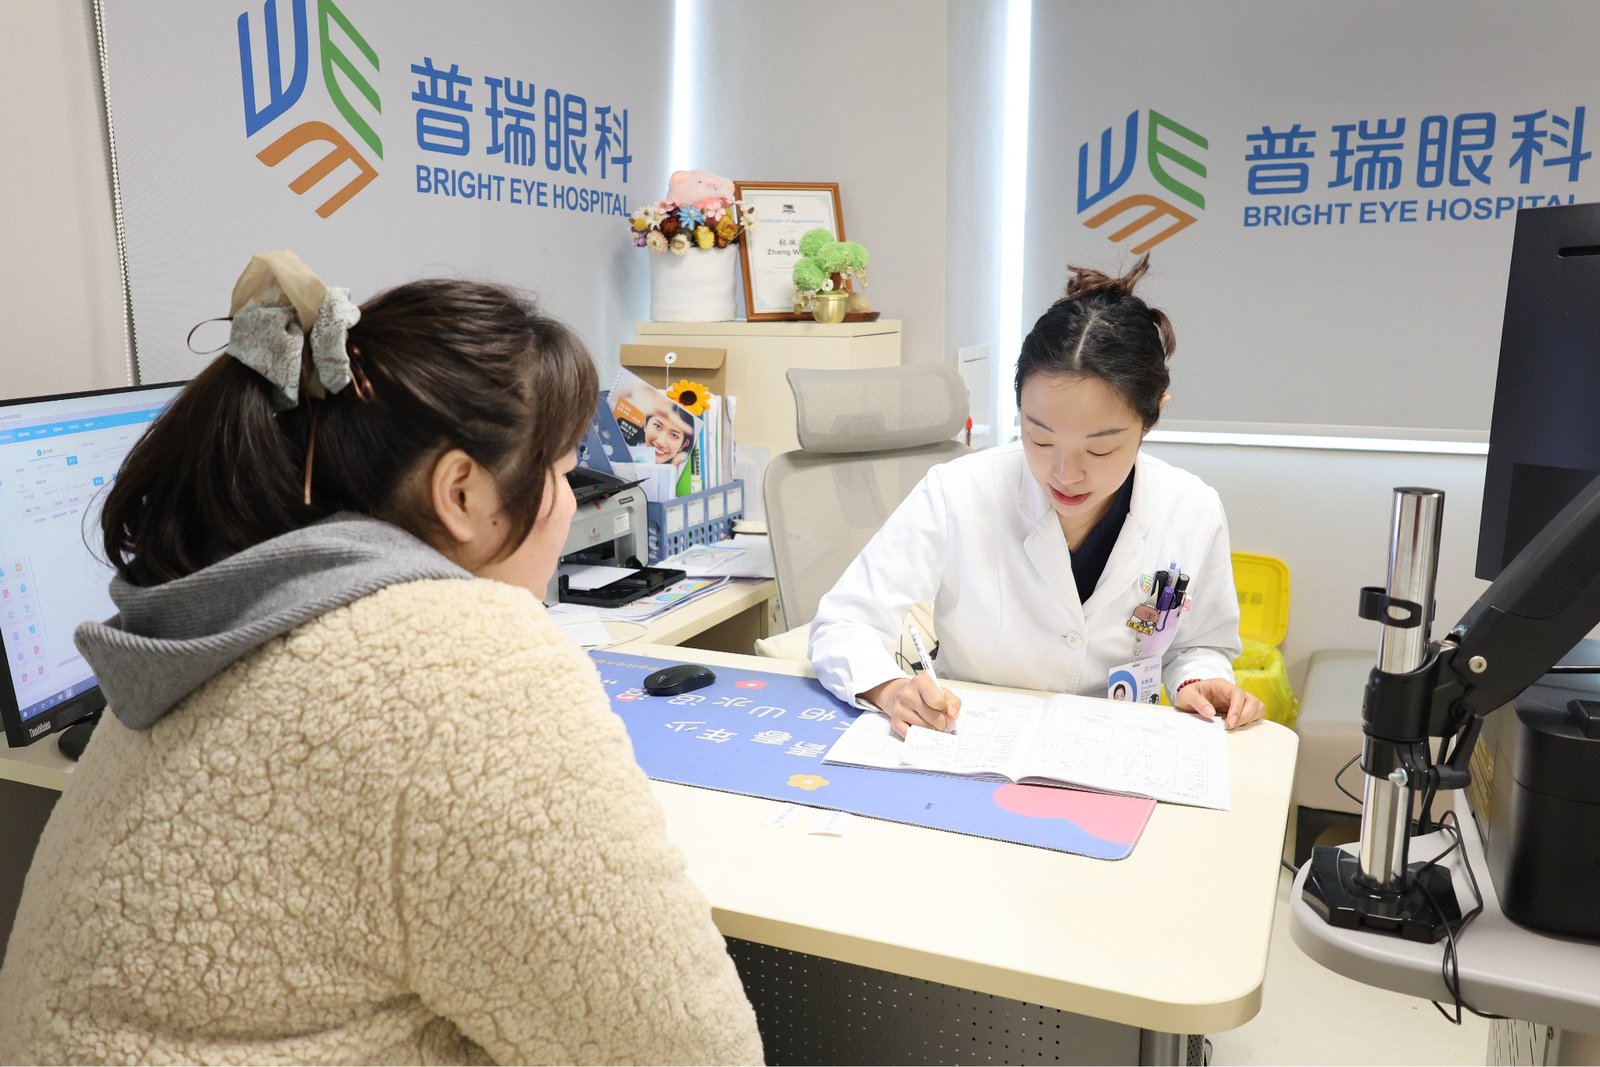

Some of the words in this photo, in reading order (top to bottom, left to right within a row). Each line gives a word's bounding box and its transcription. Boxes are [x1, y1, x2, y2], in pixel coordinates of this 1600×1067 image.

[410, 56, 633, 183] 普瑞眼科
[1244, 105, 1593, 196] 普瑞眼科
[416, 164, 505, 203] BRIGHT
[509, 177, 548, 207] EYE
[552, 185, 631, 218] HOSPITAL
[1243, 202, 1352, 228] BRIGHT
[1359, 199, 1416, 224] EYE
